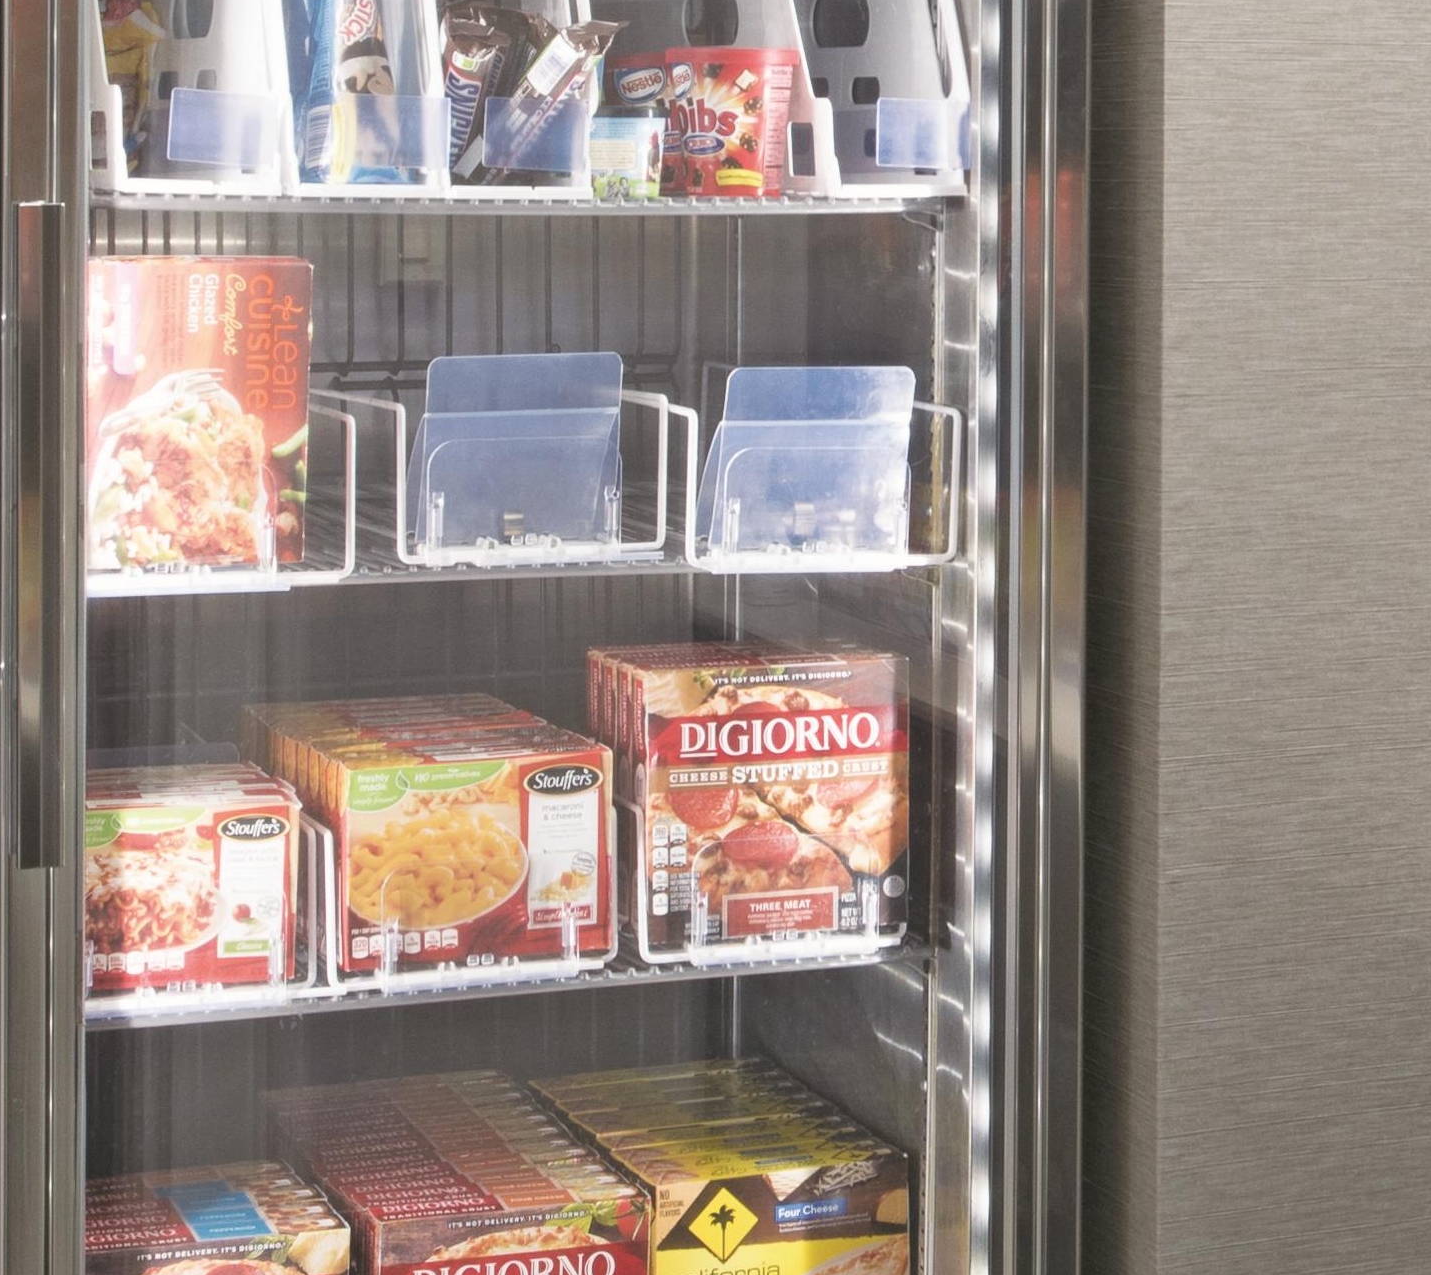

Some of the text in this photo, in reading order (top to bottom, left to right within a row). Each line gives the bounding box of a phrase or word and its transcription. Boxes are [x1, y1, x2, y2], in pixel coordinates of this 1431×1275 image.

[187, 274, 204, 334] Chicken
[203, 274, 220, 326] Glazed
[219, 272, 248, 356] Comfort
[271, 324, 300, 411] Lean
[715, 671, 807, 686] IT'S NOT IT'S
[679, 711, 882, 759] DIGIORNO
[532, 767, 593, 791] Stouffer's
[670, 758, 888, 785] CHEESE STUFFED CRUST
[541, 802, 584, 814] macaroni
[550, 812, 583, 821] cheese
[226, 817, 281, 839] Stouffer's
[749, 898, 812, 913] THREE MEAT
[777, 1200, 840, 1219] Four Cheese
[447, 1213, 544, 1230] IT'S NOT IT'S
[136, 1245, 237, 1262] IT'S NOT IT'S
